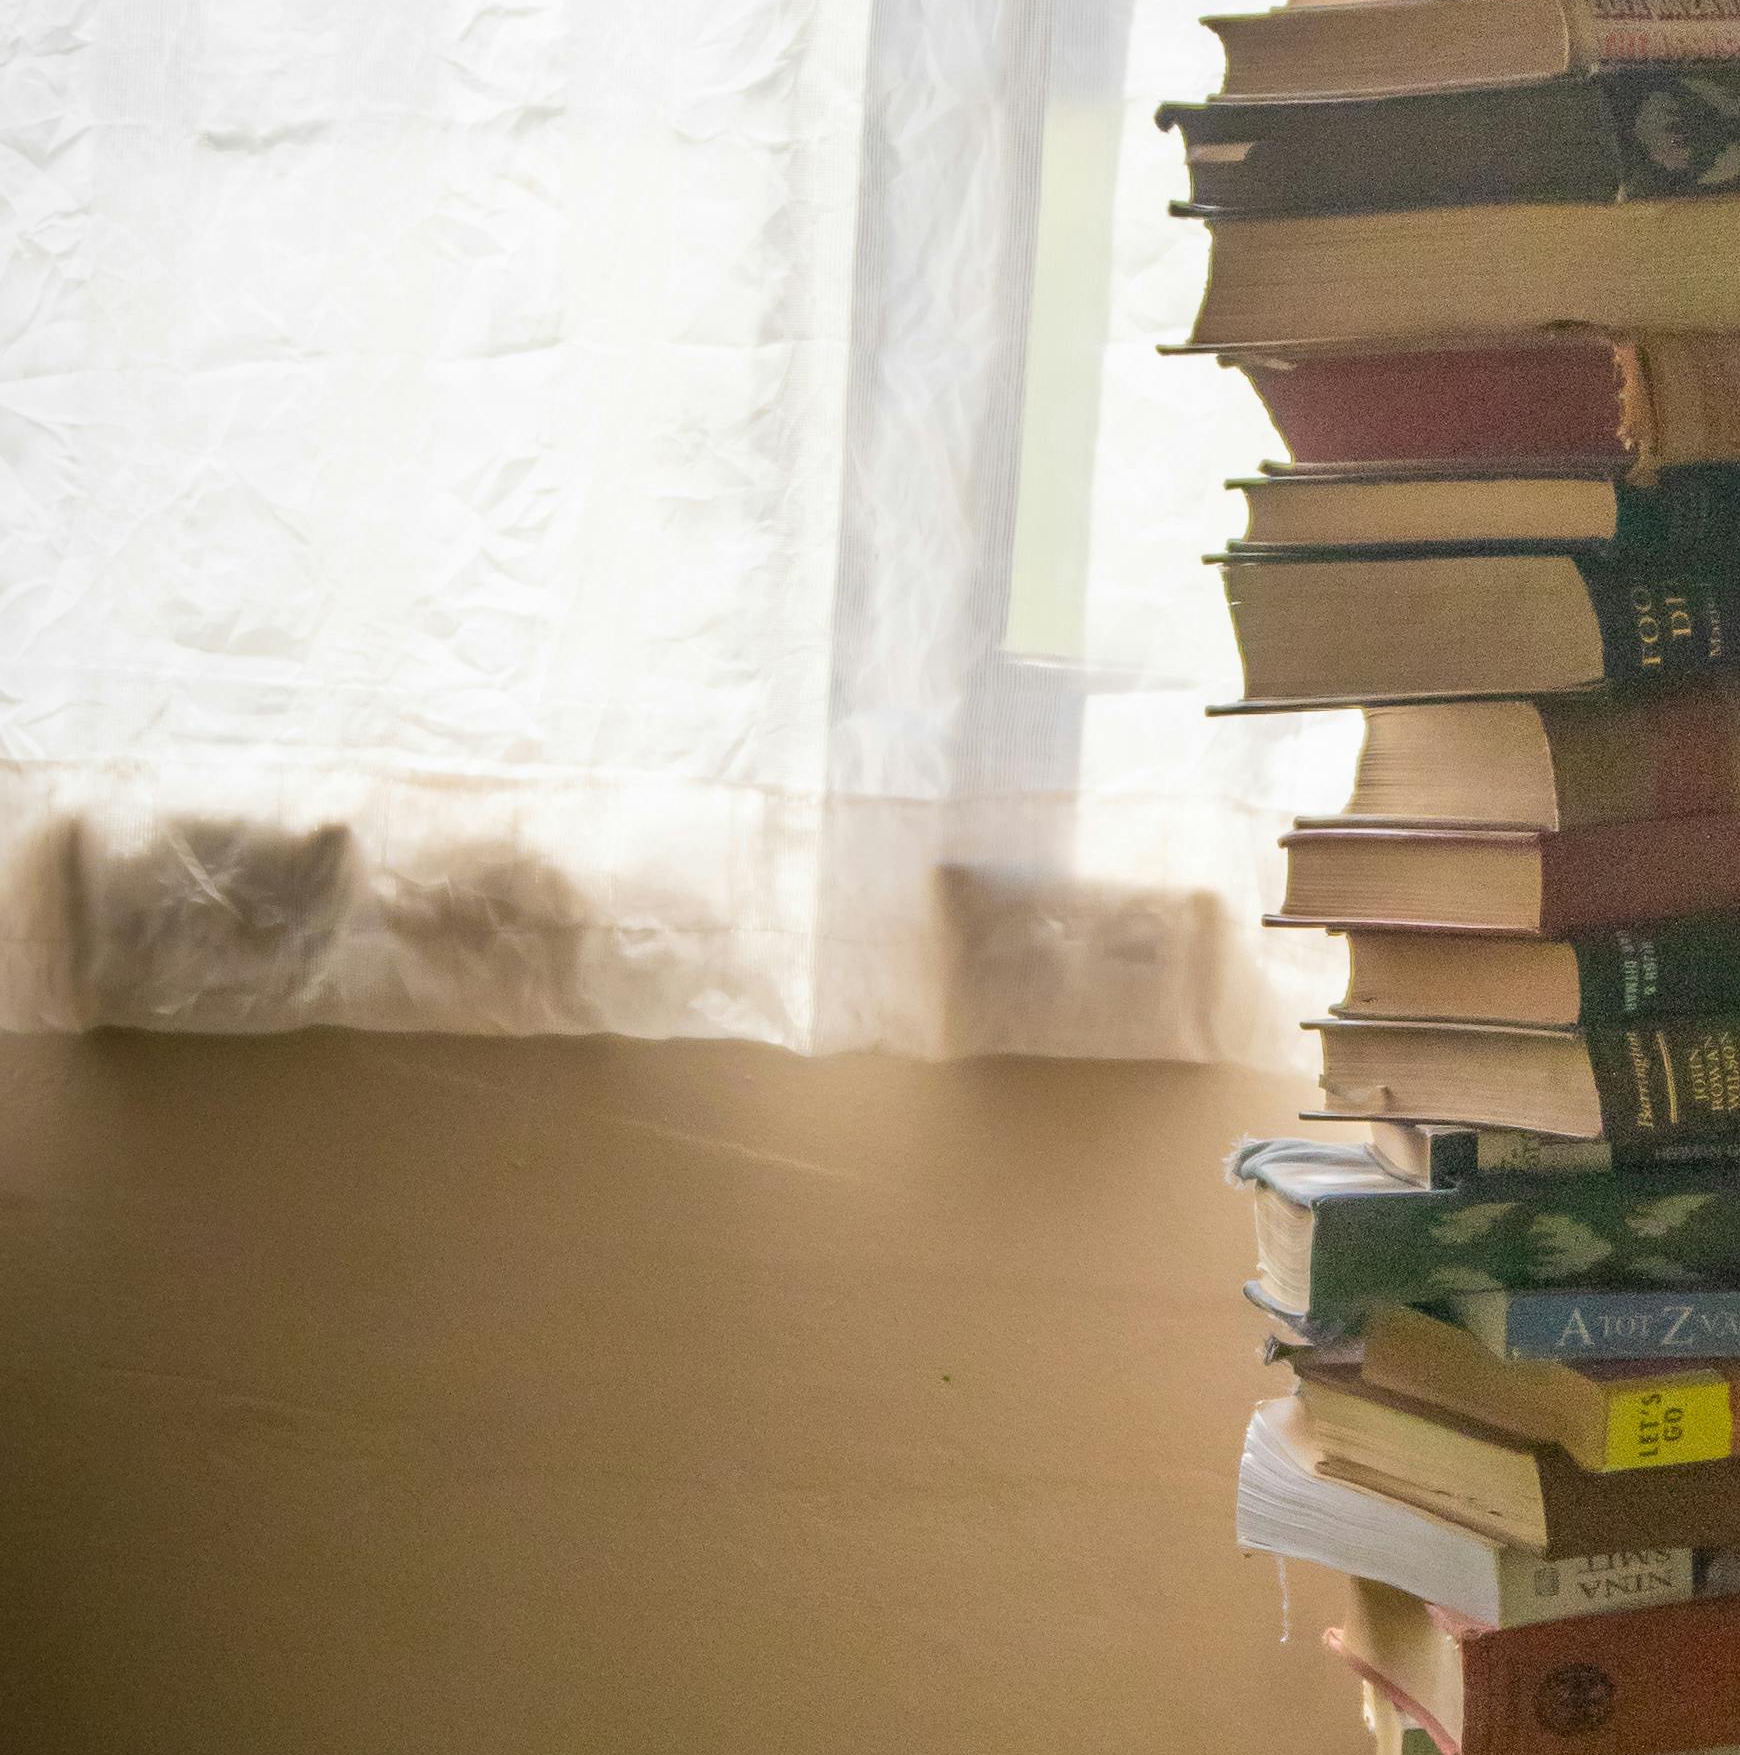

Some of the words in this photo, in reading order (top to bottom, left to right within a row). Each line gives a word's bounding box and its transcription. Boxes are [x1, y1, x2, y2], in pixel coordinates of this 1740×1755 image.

[1556, 1308, 1595, 1347] A
[1599, 1314, 1654, 1336] TOT
[1661, 1307, 1700, 1346] Z
[1640, 1392, 1663, 1458] LET'S
[1664, 1405, 1684, 1443] GO
[1578, 1574, 1674, 1598] NINA
